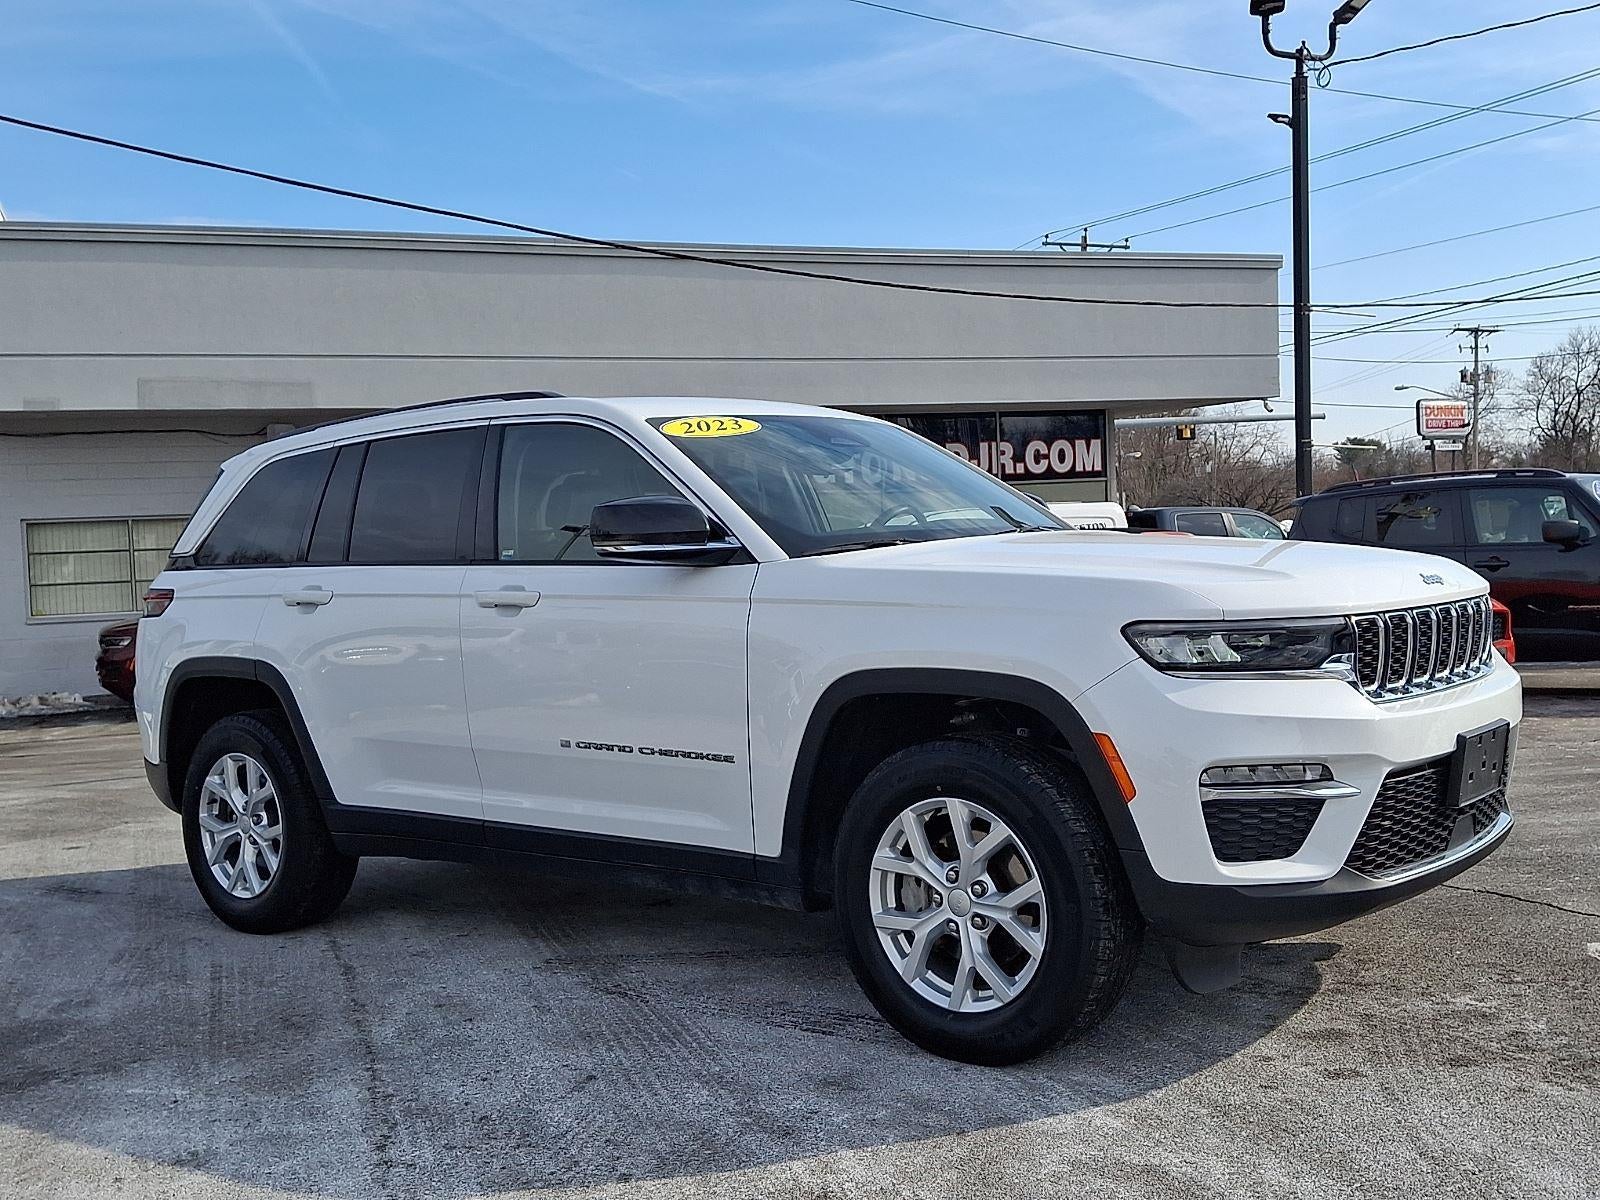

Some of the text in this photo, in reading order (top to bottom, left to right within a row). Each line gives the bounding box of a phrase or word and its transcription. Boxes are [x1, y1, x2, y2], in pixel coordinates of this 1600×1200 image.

[680, 419, 742, 434] 2023
[1428, 420, 1447, 428] DRIVE
[575, 740, 736, 764] GRAND CHEROKEE
